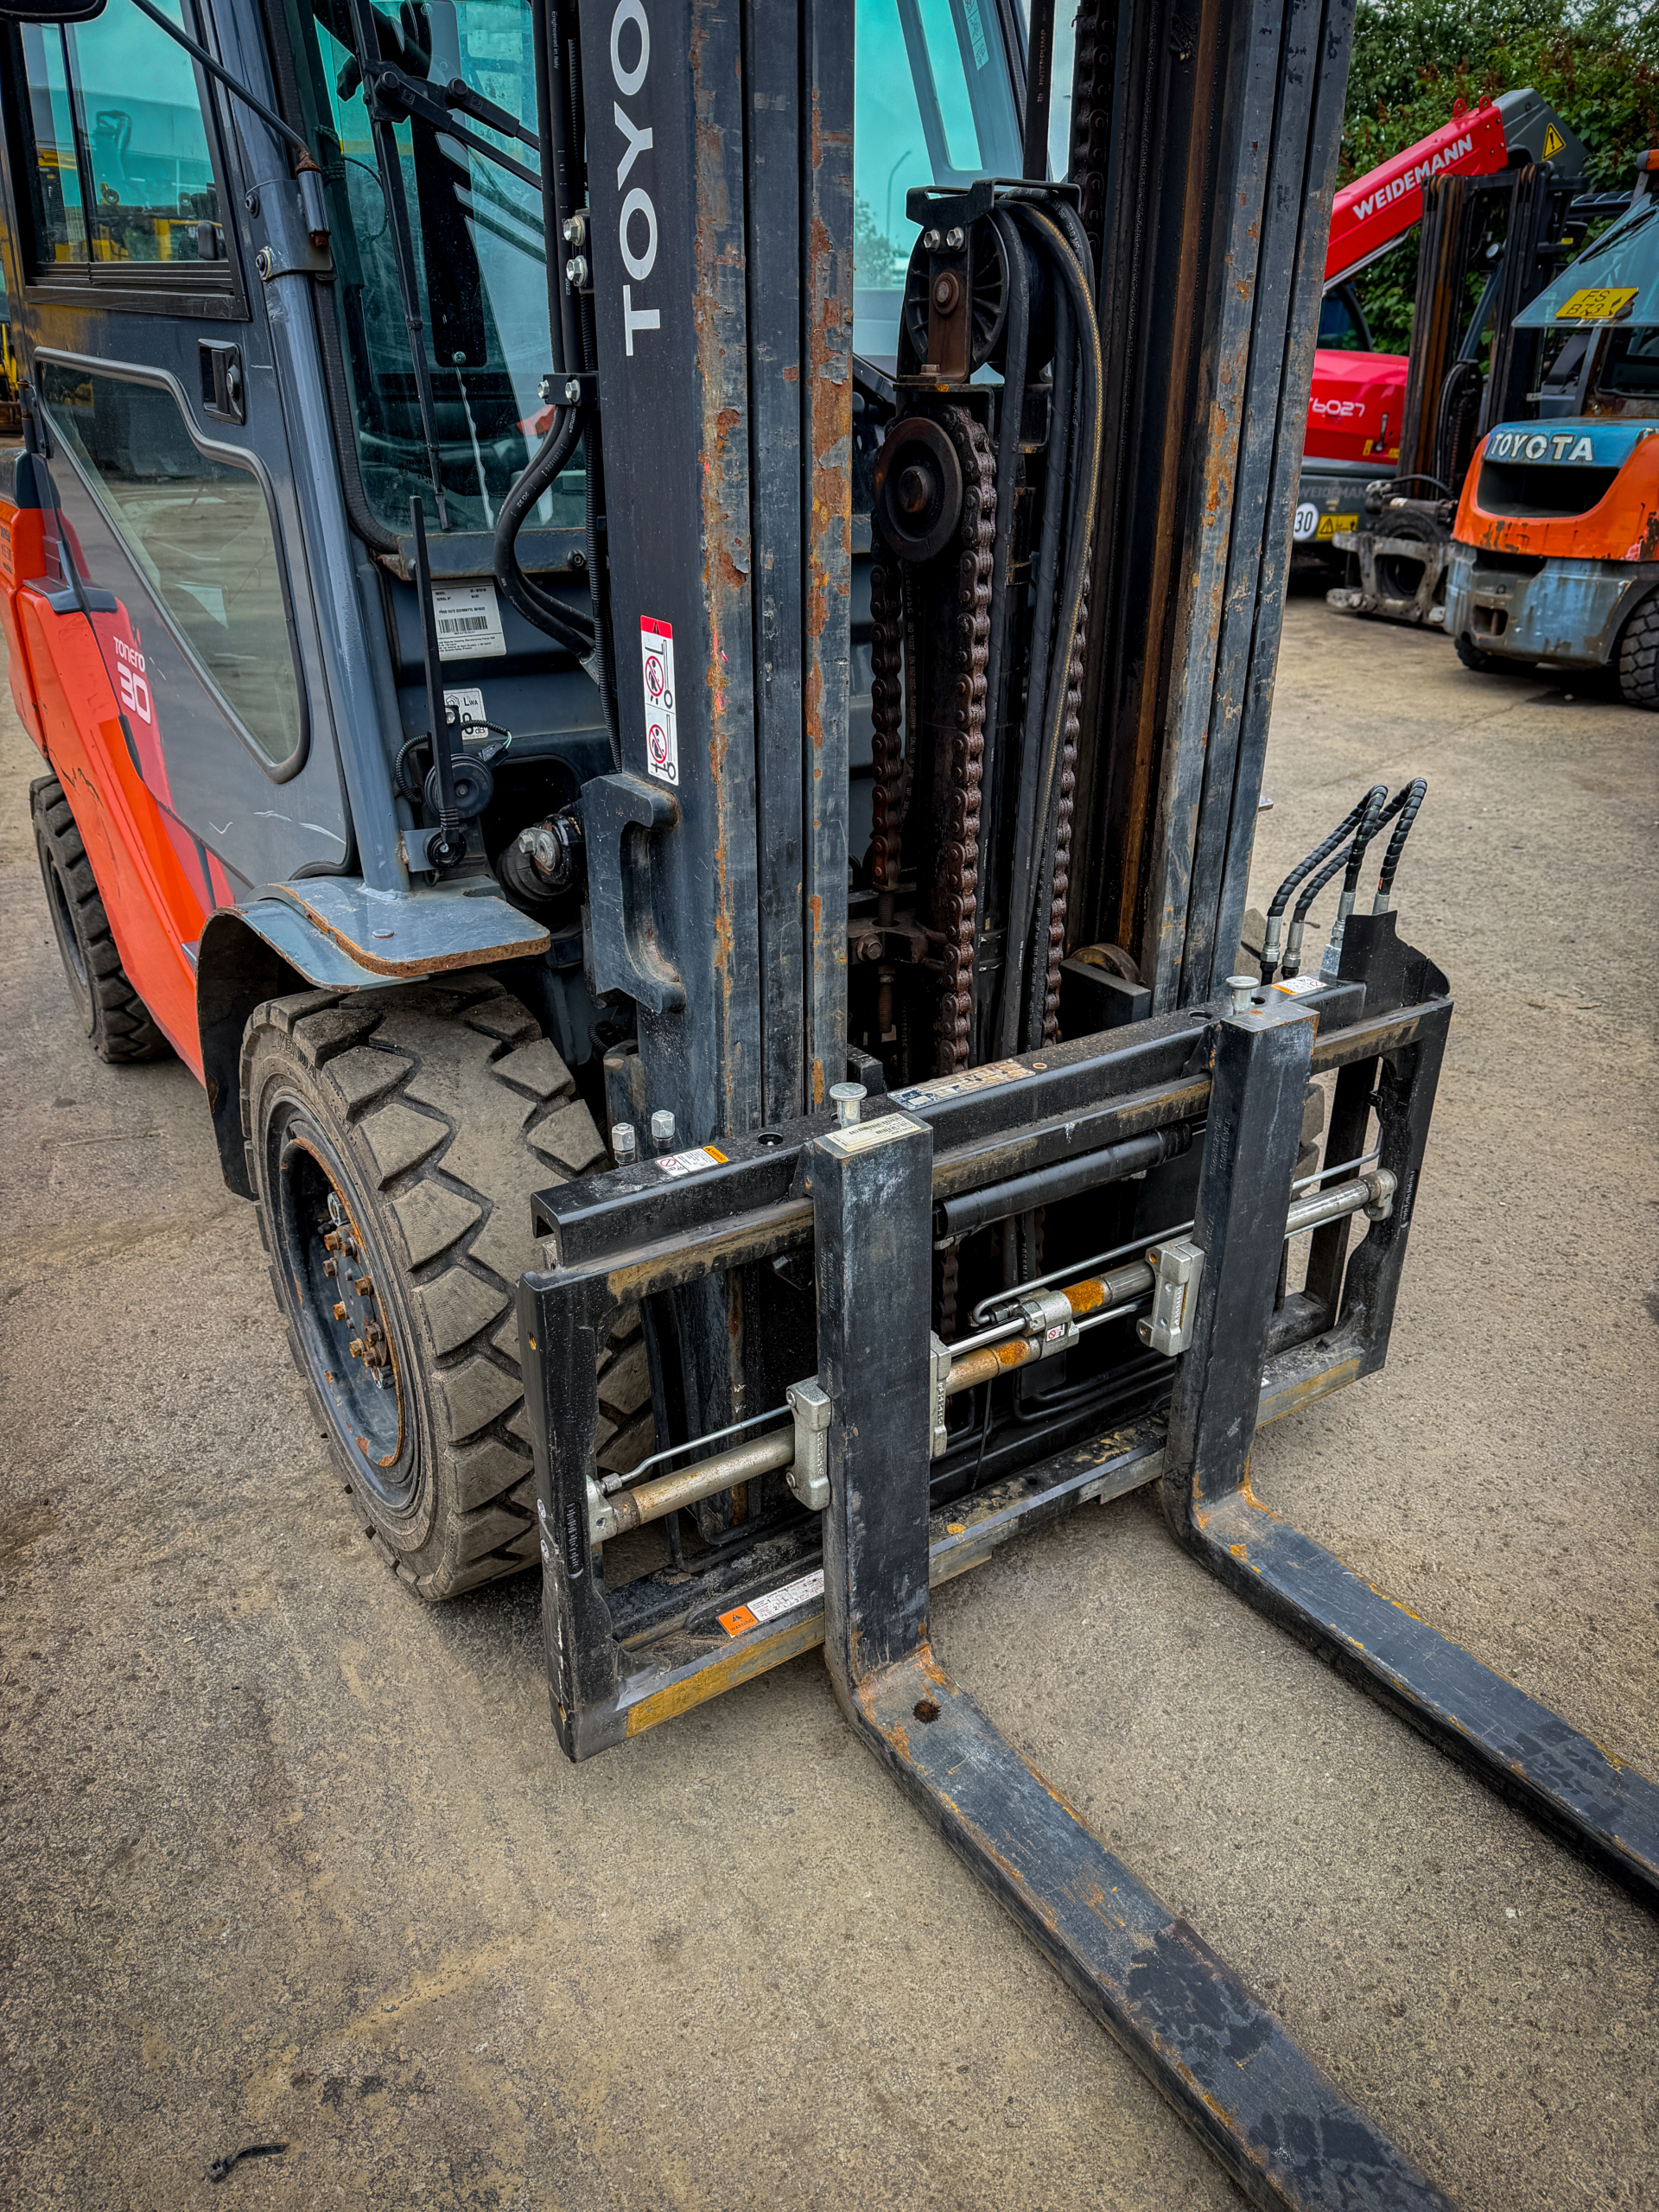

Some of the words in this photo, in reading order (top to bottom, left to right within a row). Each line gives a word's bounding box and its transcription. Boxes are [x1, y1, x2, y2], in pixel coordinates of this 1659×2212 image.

[1352, 134, 1472, 220] WEIDEMANN
[1582, 290, 1610, 302] FS
[1309, 397, 1365, 418] 6027
[1490, 433, 1593, 461] TOYOTA
[1299, 485, 1366, 499] WEIDEMAN
[1295, 511, 1313, 532] 30
[112, 635, 145, 673] TONERO
[118, 661, 151, 725] 30
